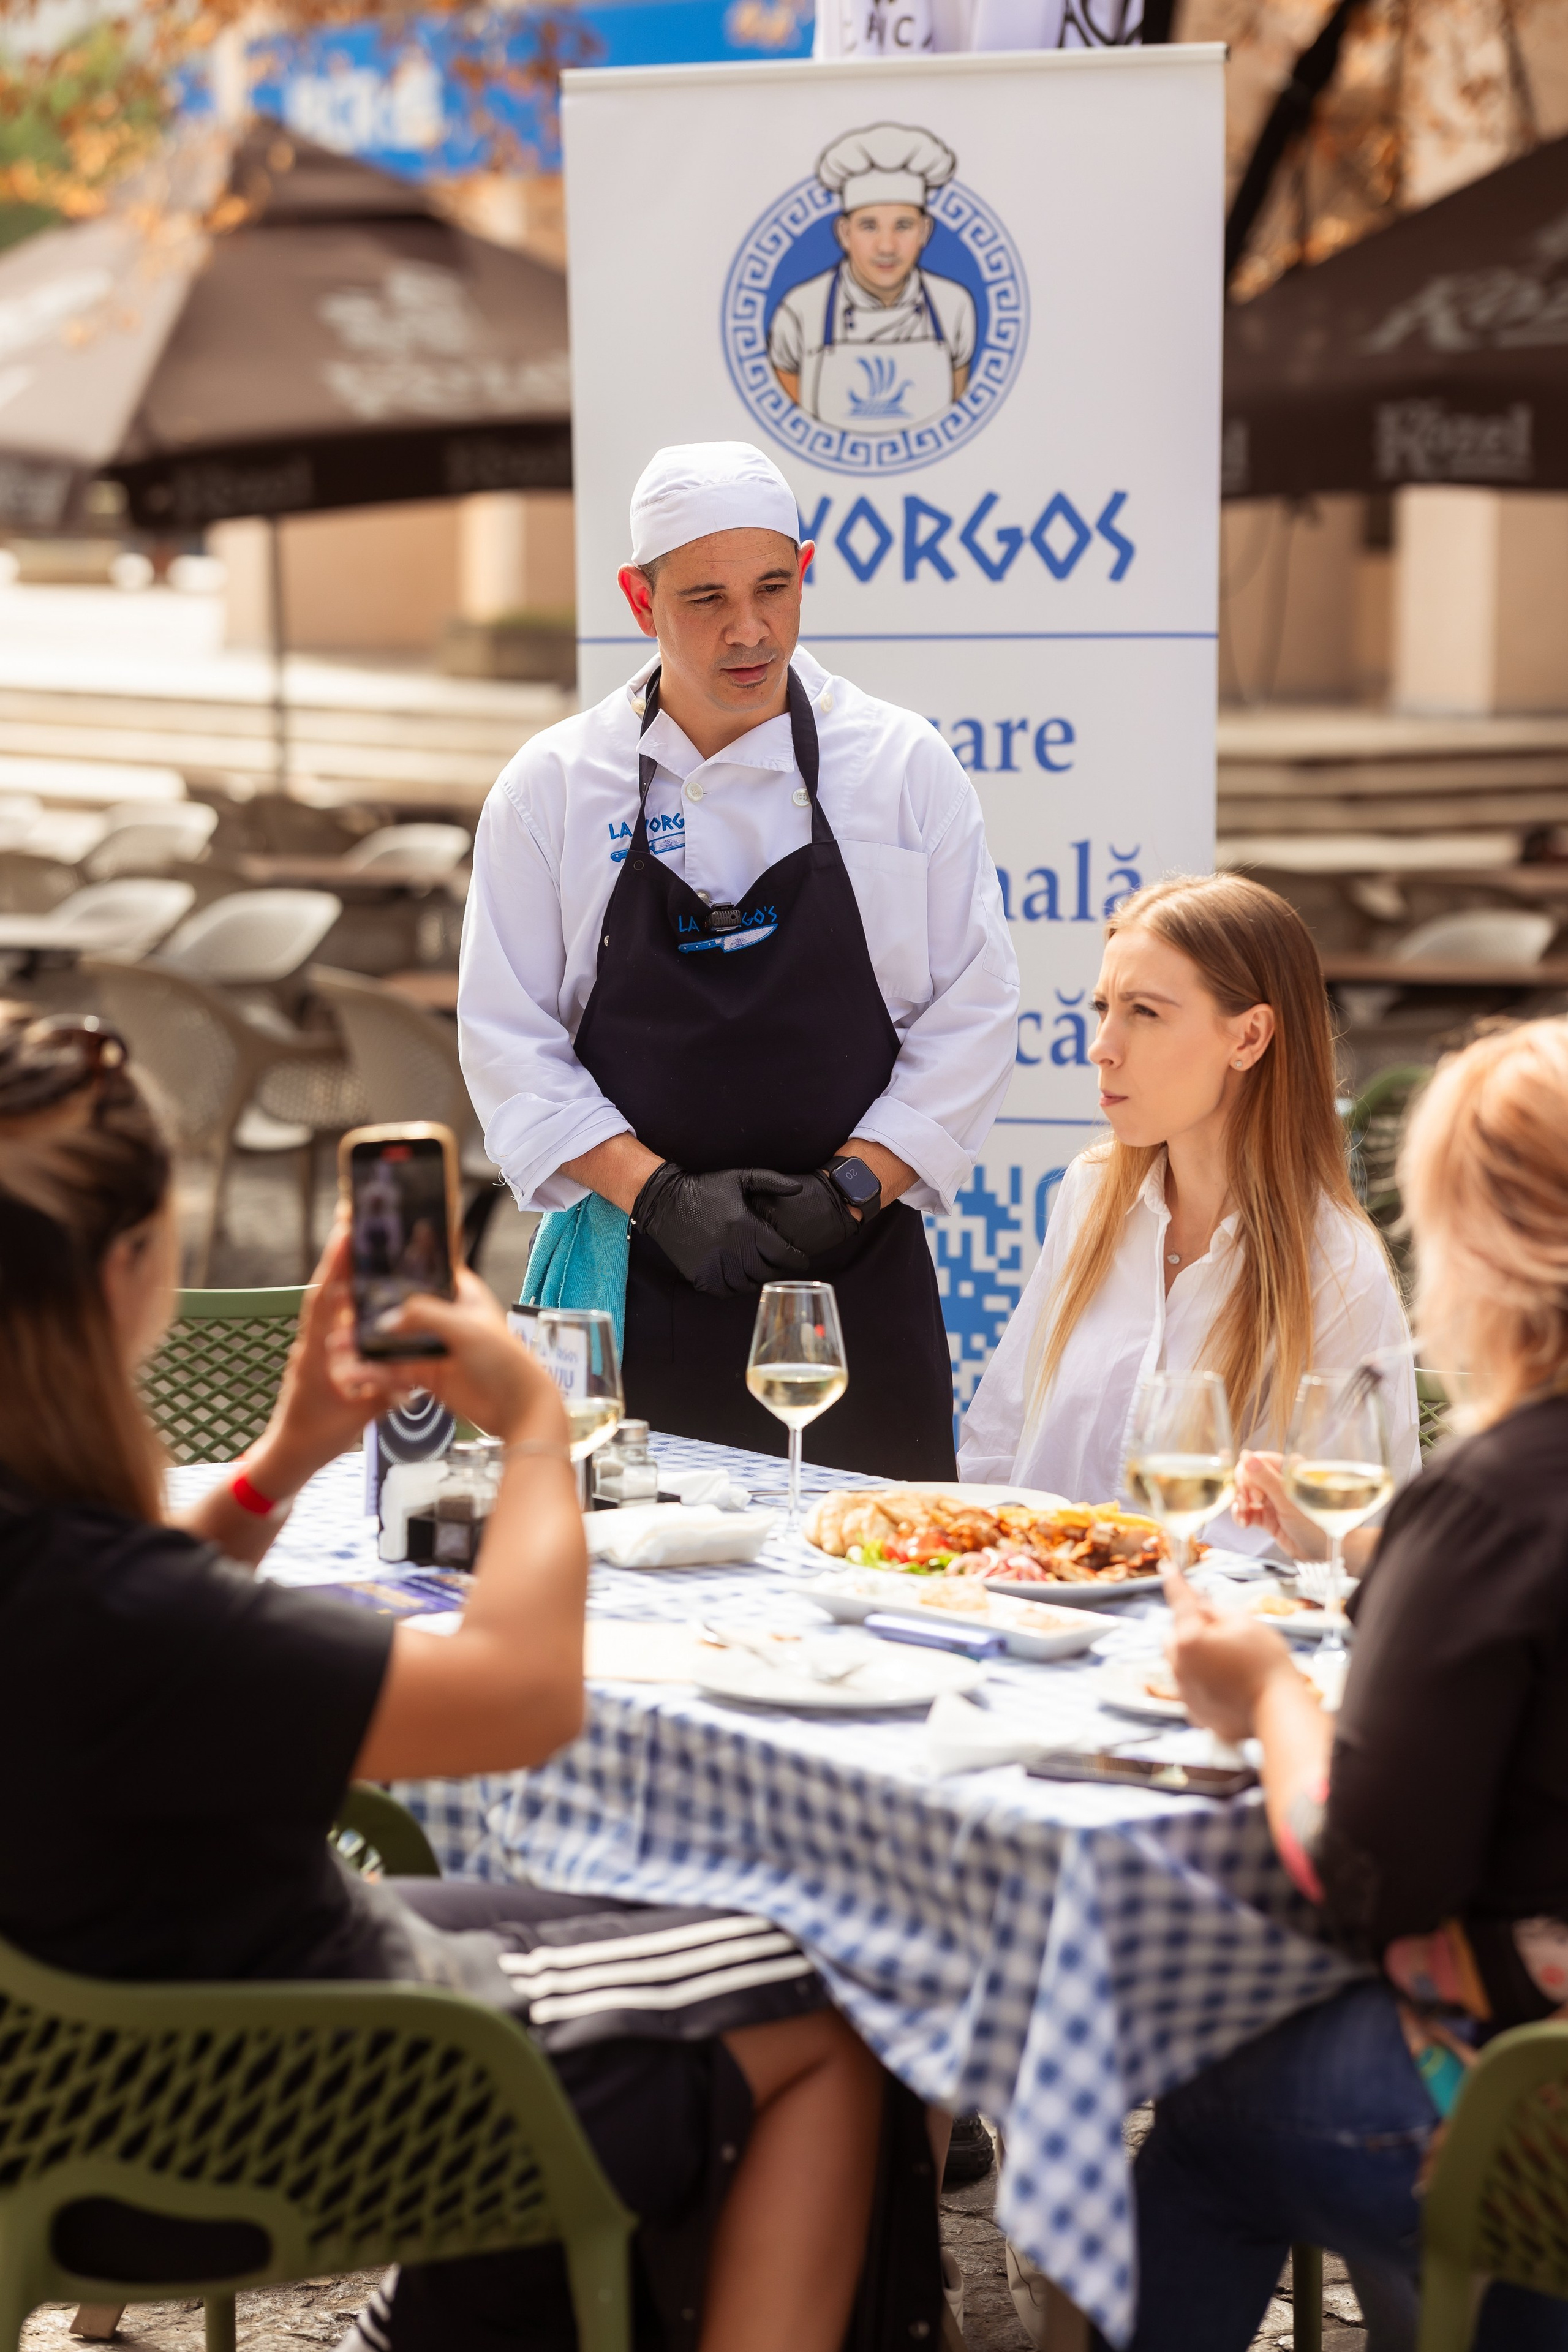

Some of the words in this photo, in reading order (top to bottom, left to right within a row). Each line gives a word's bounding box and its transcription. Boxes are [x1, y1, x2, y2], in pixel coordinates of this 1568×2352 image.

[927, 715, 1076, 774] are
[608, 821, 633, 840] LA
[679, 915, 700, 932] LA
[737, 905, 777, 928] GO'S
[845, 1168, 858, 1180] 20
